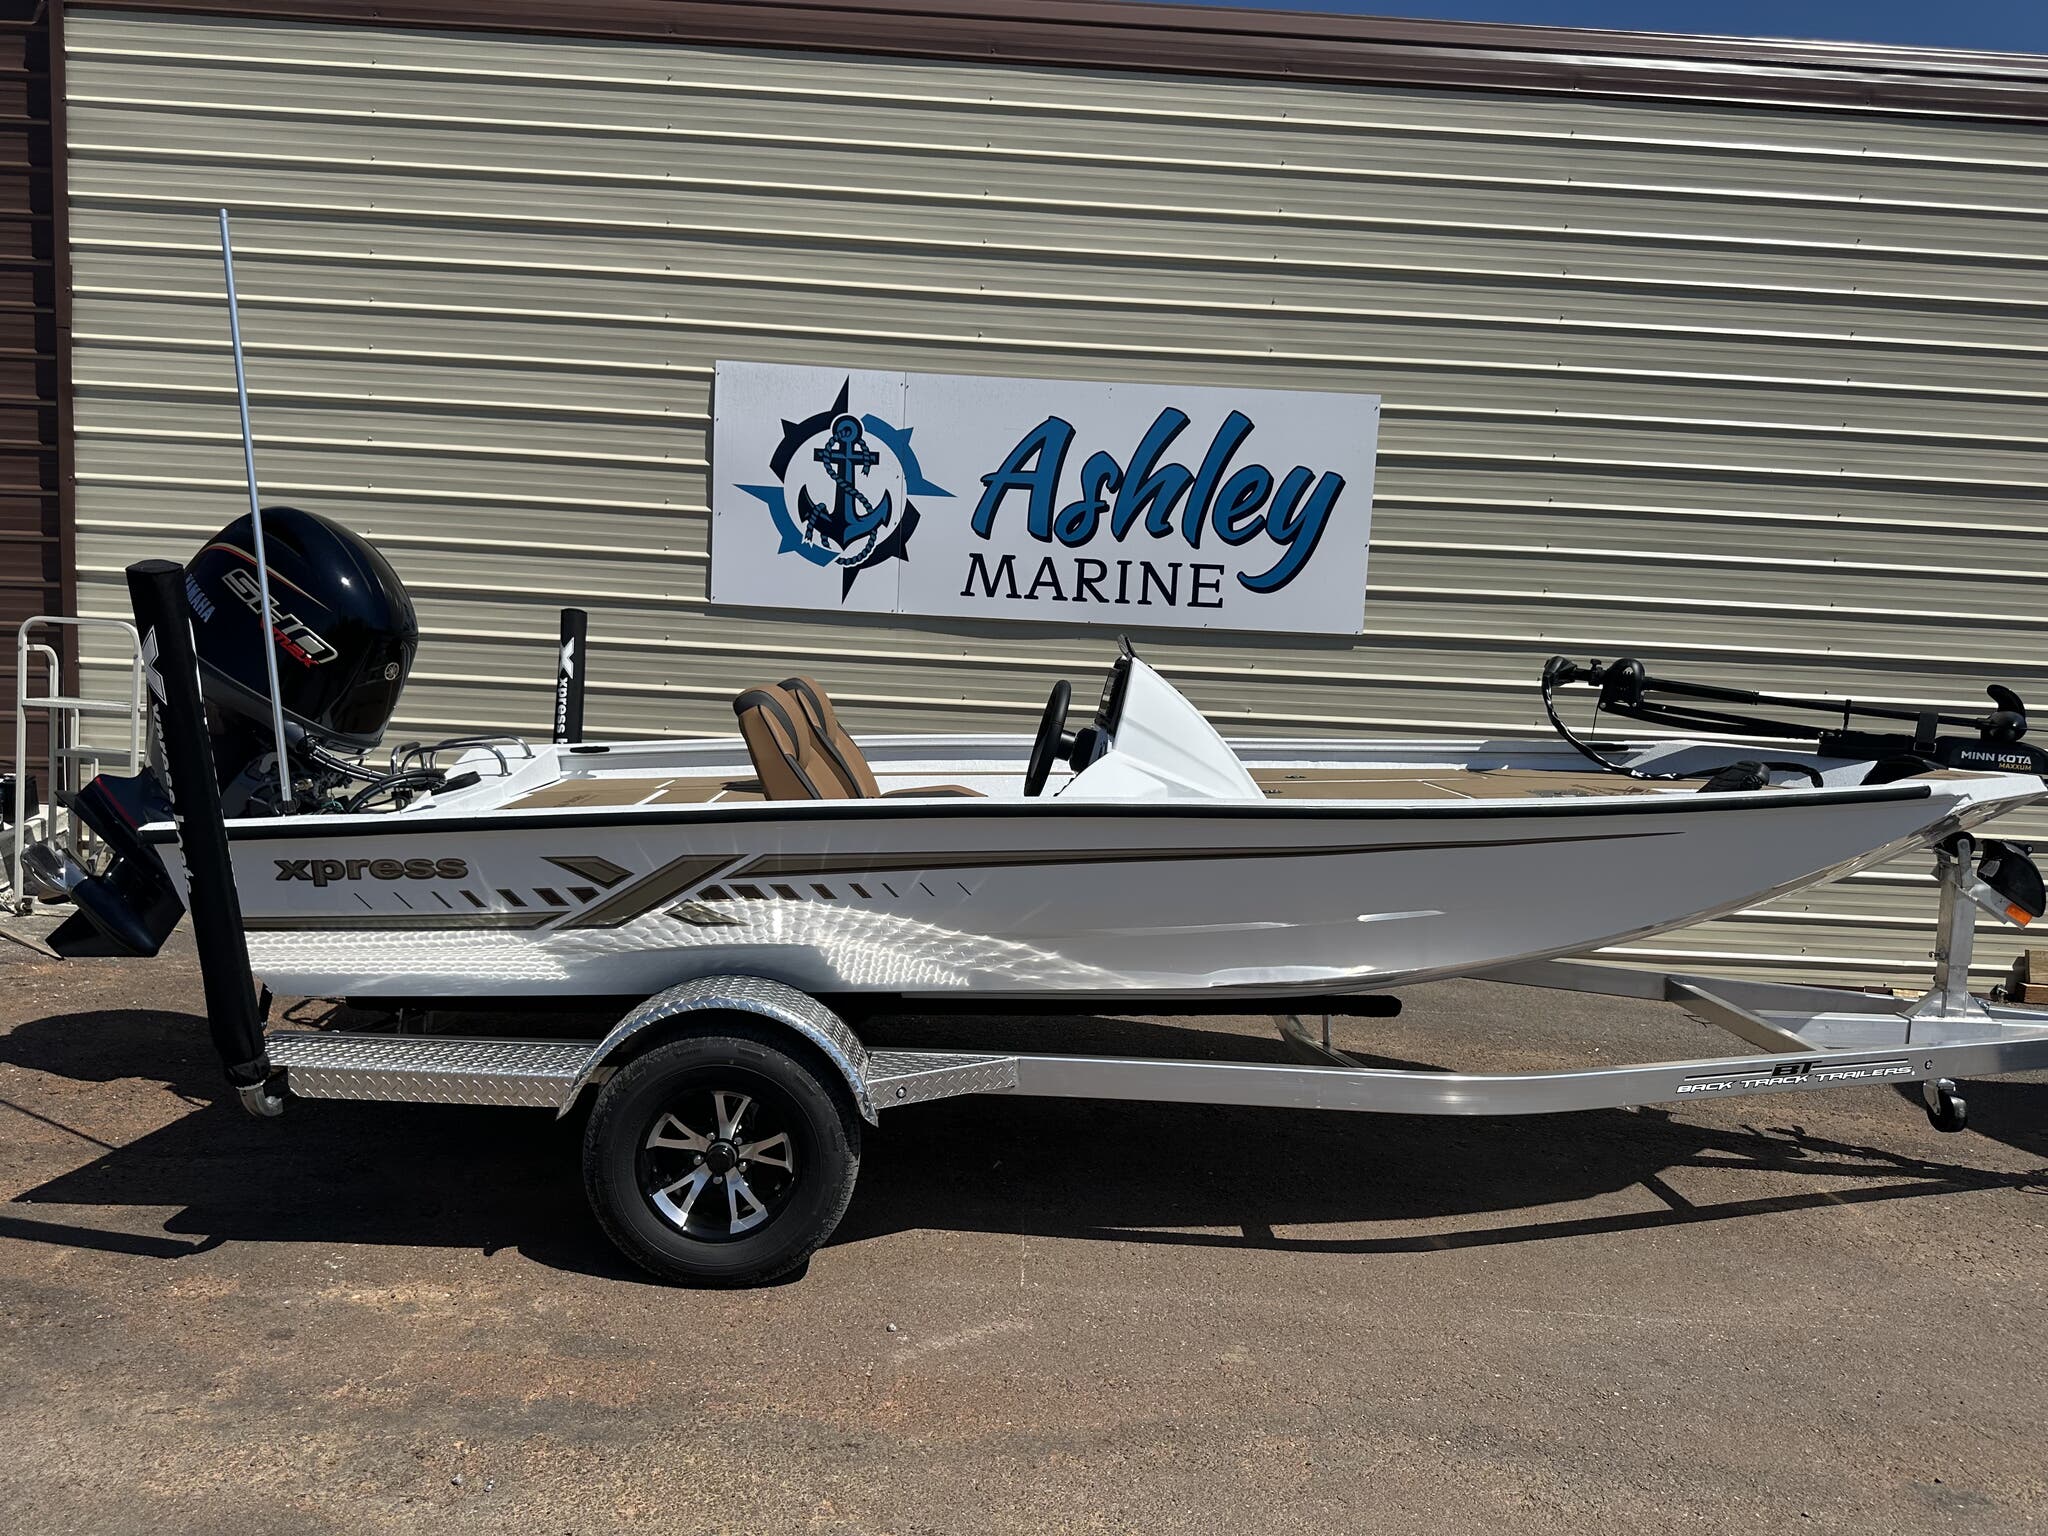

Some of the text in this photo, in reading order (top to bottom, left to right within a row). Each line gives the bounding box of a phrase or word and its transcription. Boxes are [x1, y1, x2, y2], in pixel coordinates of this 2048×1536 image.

[971, 406, 1346, 594] Ashley
[960, 552, 1225, 608] MARINE
[1960, 750, 2032, 765] MINN KOTA
[1999, 762, 2032, 771] MAXXUM
[274, 858, 469, 887] xpress
[1771, 1060, 1822, 1077] BT
[1676, 1081, 1737, 1094] BACK
[1740, 1074, 1812, 1089] TRACK
